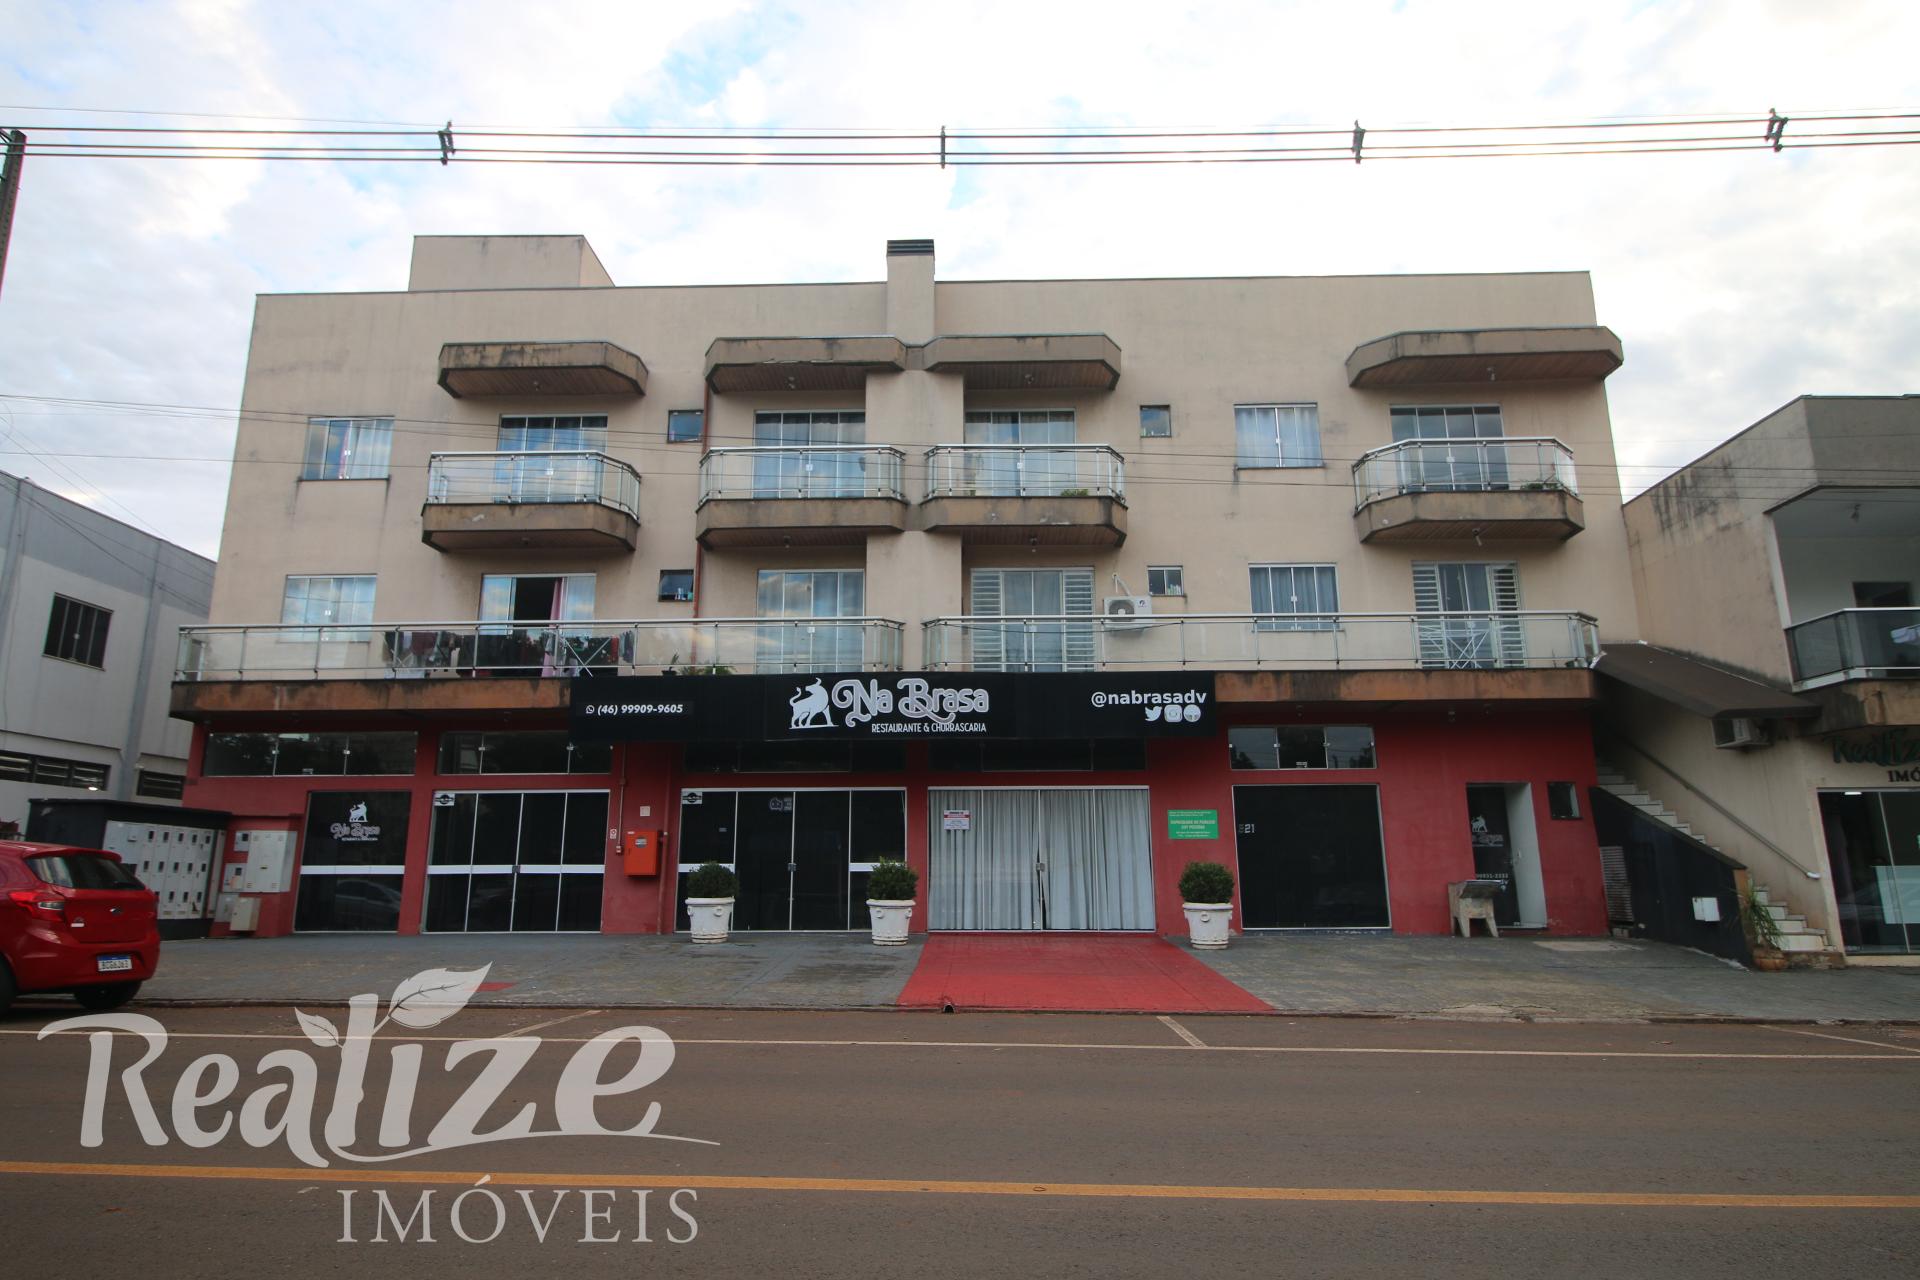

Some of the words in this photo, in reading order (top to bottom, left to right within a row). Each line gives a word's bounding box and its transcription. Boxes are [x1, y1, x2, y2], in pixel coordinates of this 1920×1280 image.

[831, 678, 893, 727] Na
[897, 677, 989, 724] Brasa
[1091, 689, 1207, 708] @nabrasadv
[597, 704, 618, 716] (46)
[621, 703, 684, 714] 99909-9605
[871, 723, 922, 733] RESTAURANTE
[923, 723, 930, 733] &
[931, 722, 987, 733] CHURRASCARIA
